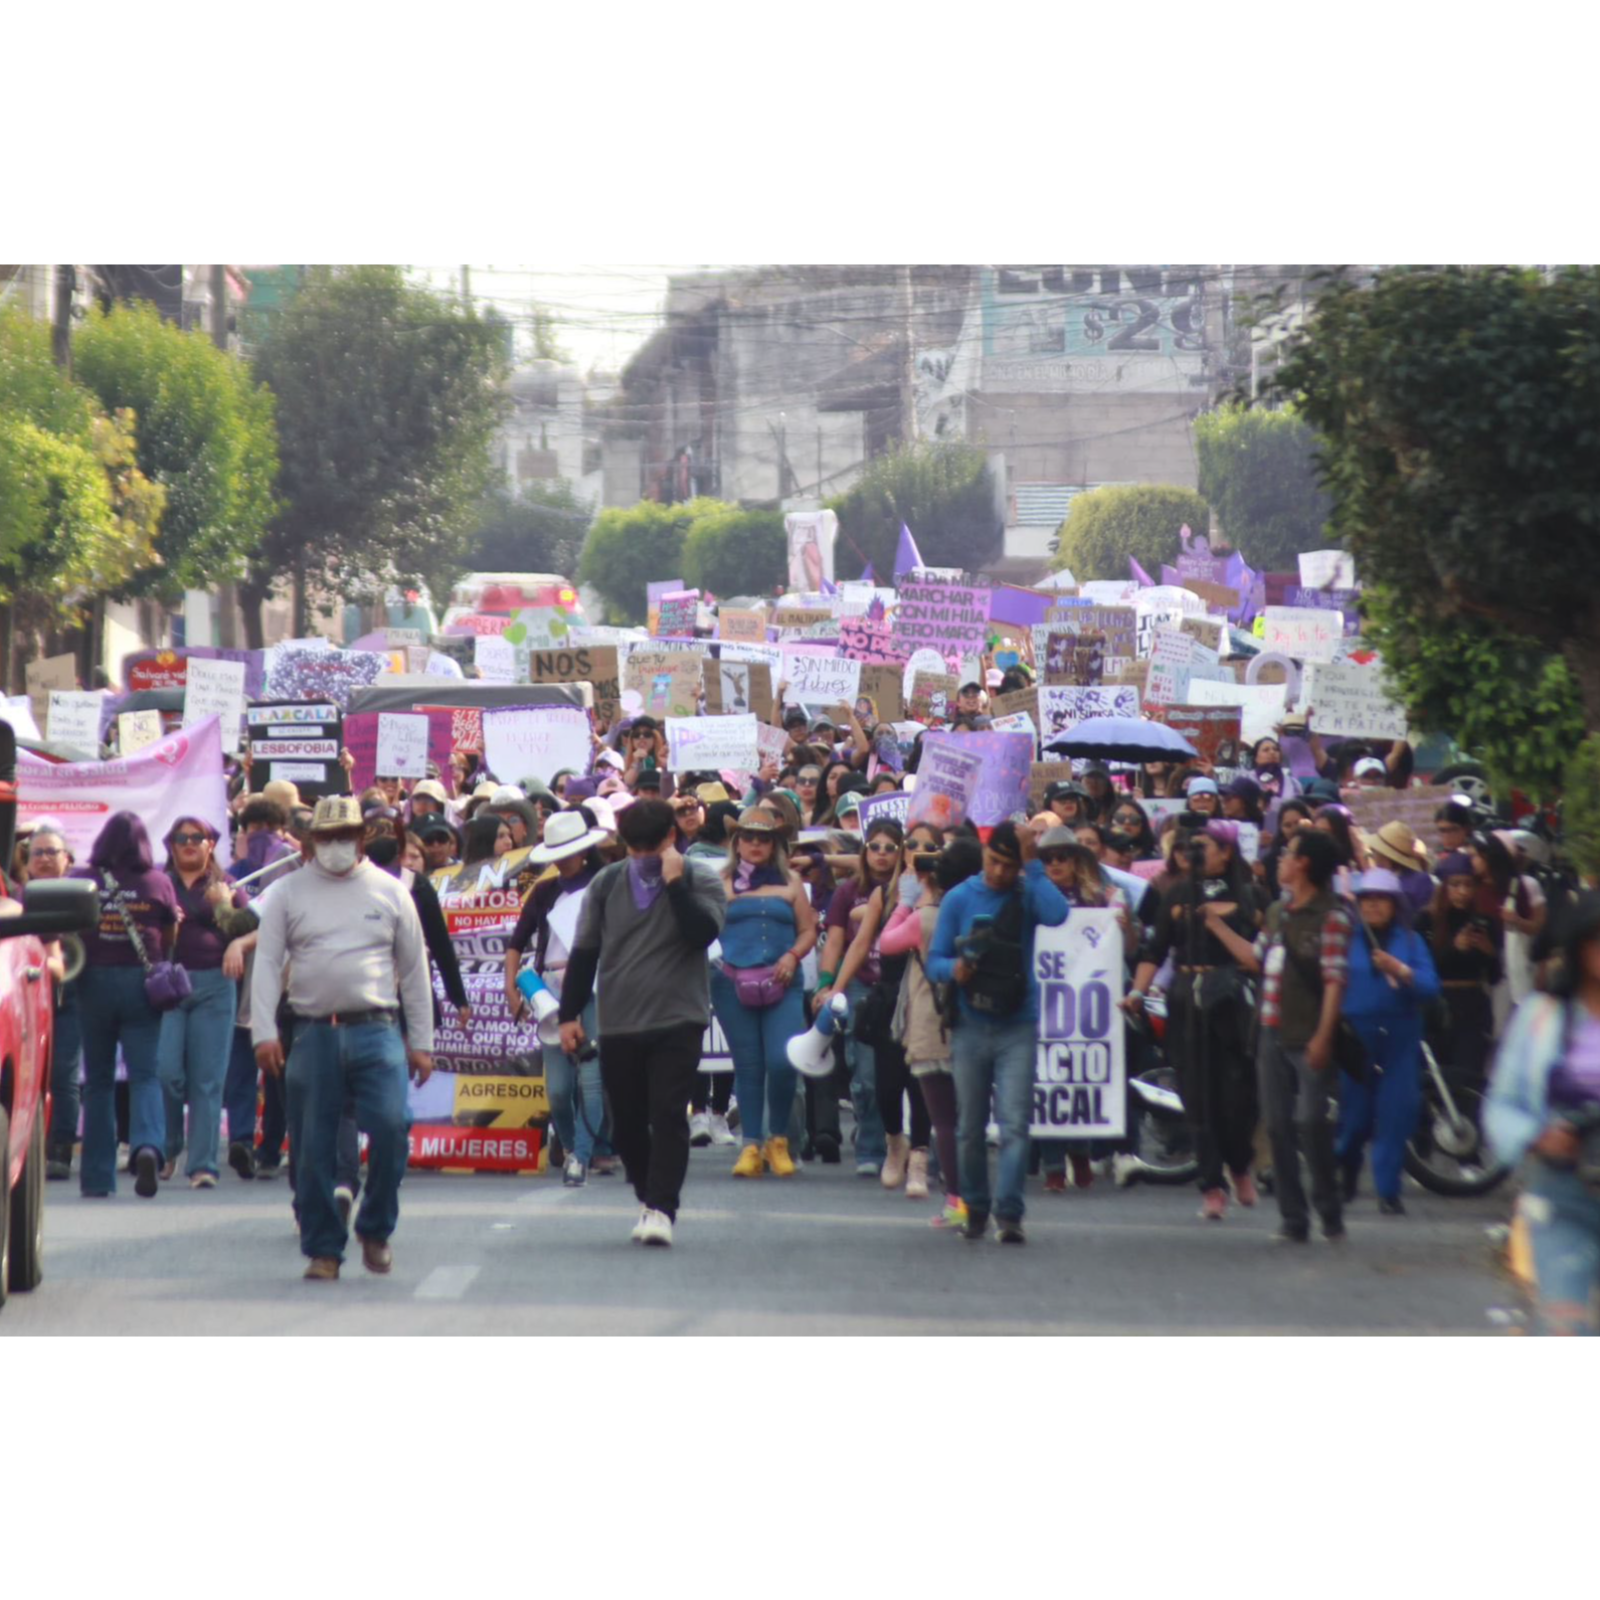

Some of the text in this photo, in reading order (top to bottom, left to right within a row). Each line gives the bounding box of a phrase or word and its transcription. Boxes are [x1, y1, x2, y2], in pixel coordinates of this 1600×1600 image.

[895, 587, 974, 606] MARCHAR
[535, 648, 593, 678] NOS
[799, 656, 824, 674] SIN
[823, 657, 857, 675] MIEDO
[252, 742, 336, 756] LESBOFOBIA
[439, 889, 525, 911] IENTOS.
[454, 915, 473, 927] NO
[474, 915, 498, 927] HAY
[1037, 950, 1066, 981] SE
[1036, 968, 1111, 1041] DÓ
[472, 1031, 503, 1046] QUE
[506, 1033, 530, 1048] NO
[459, 1082, 544, 1099] AGRESOR
[1030, 1084, 1111, 1126] RCAL
[420, 1137, 534, 1161] MUJERES.
